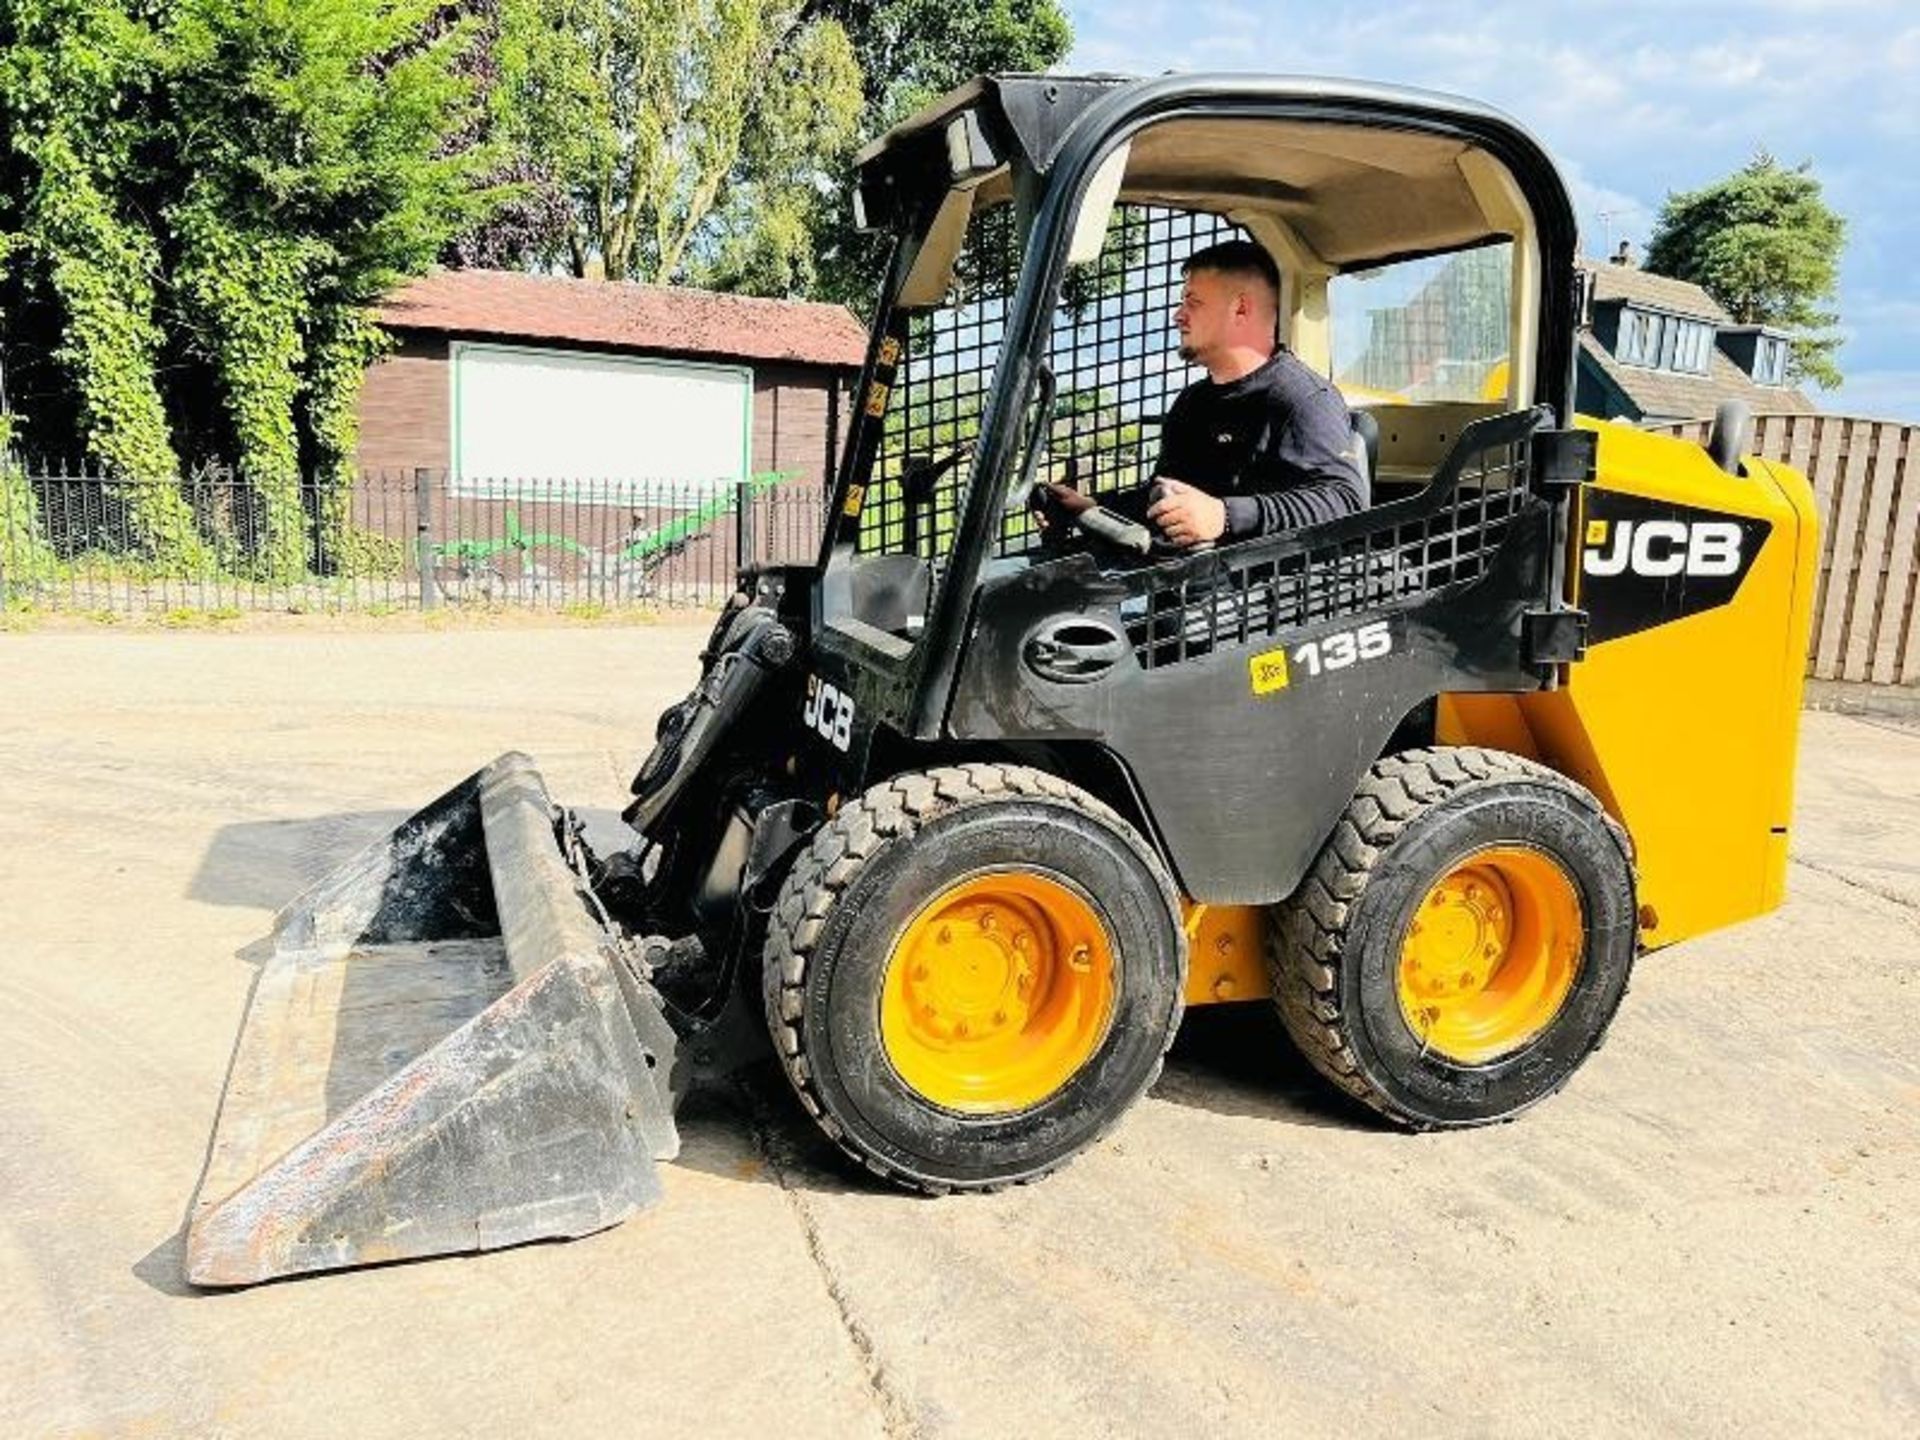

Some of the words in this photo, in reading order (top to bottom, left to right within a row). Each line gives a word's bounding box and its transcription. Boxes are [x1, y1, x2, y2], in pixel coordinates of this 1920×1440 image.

[1583, 520, 1743, 577] JCB
[1293, 621, 1392, 676] 135
[803, 676, 855, 752] JCB
